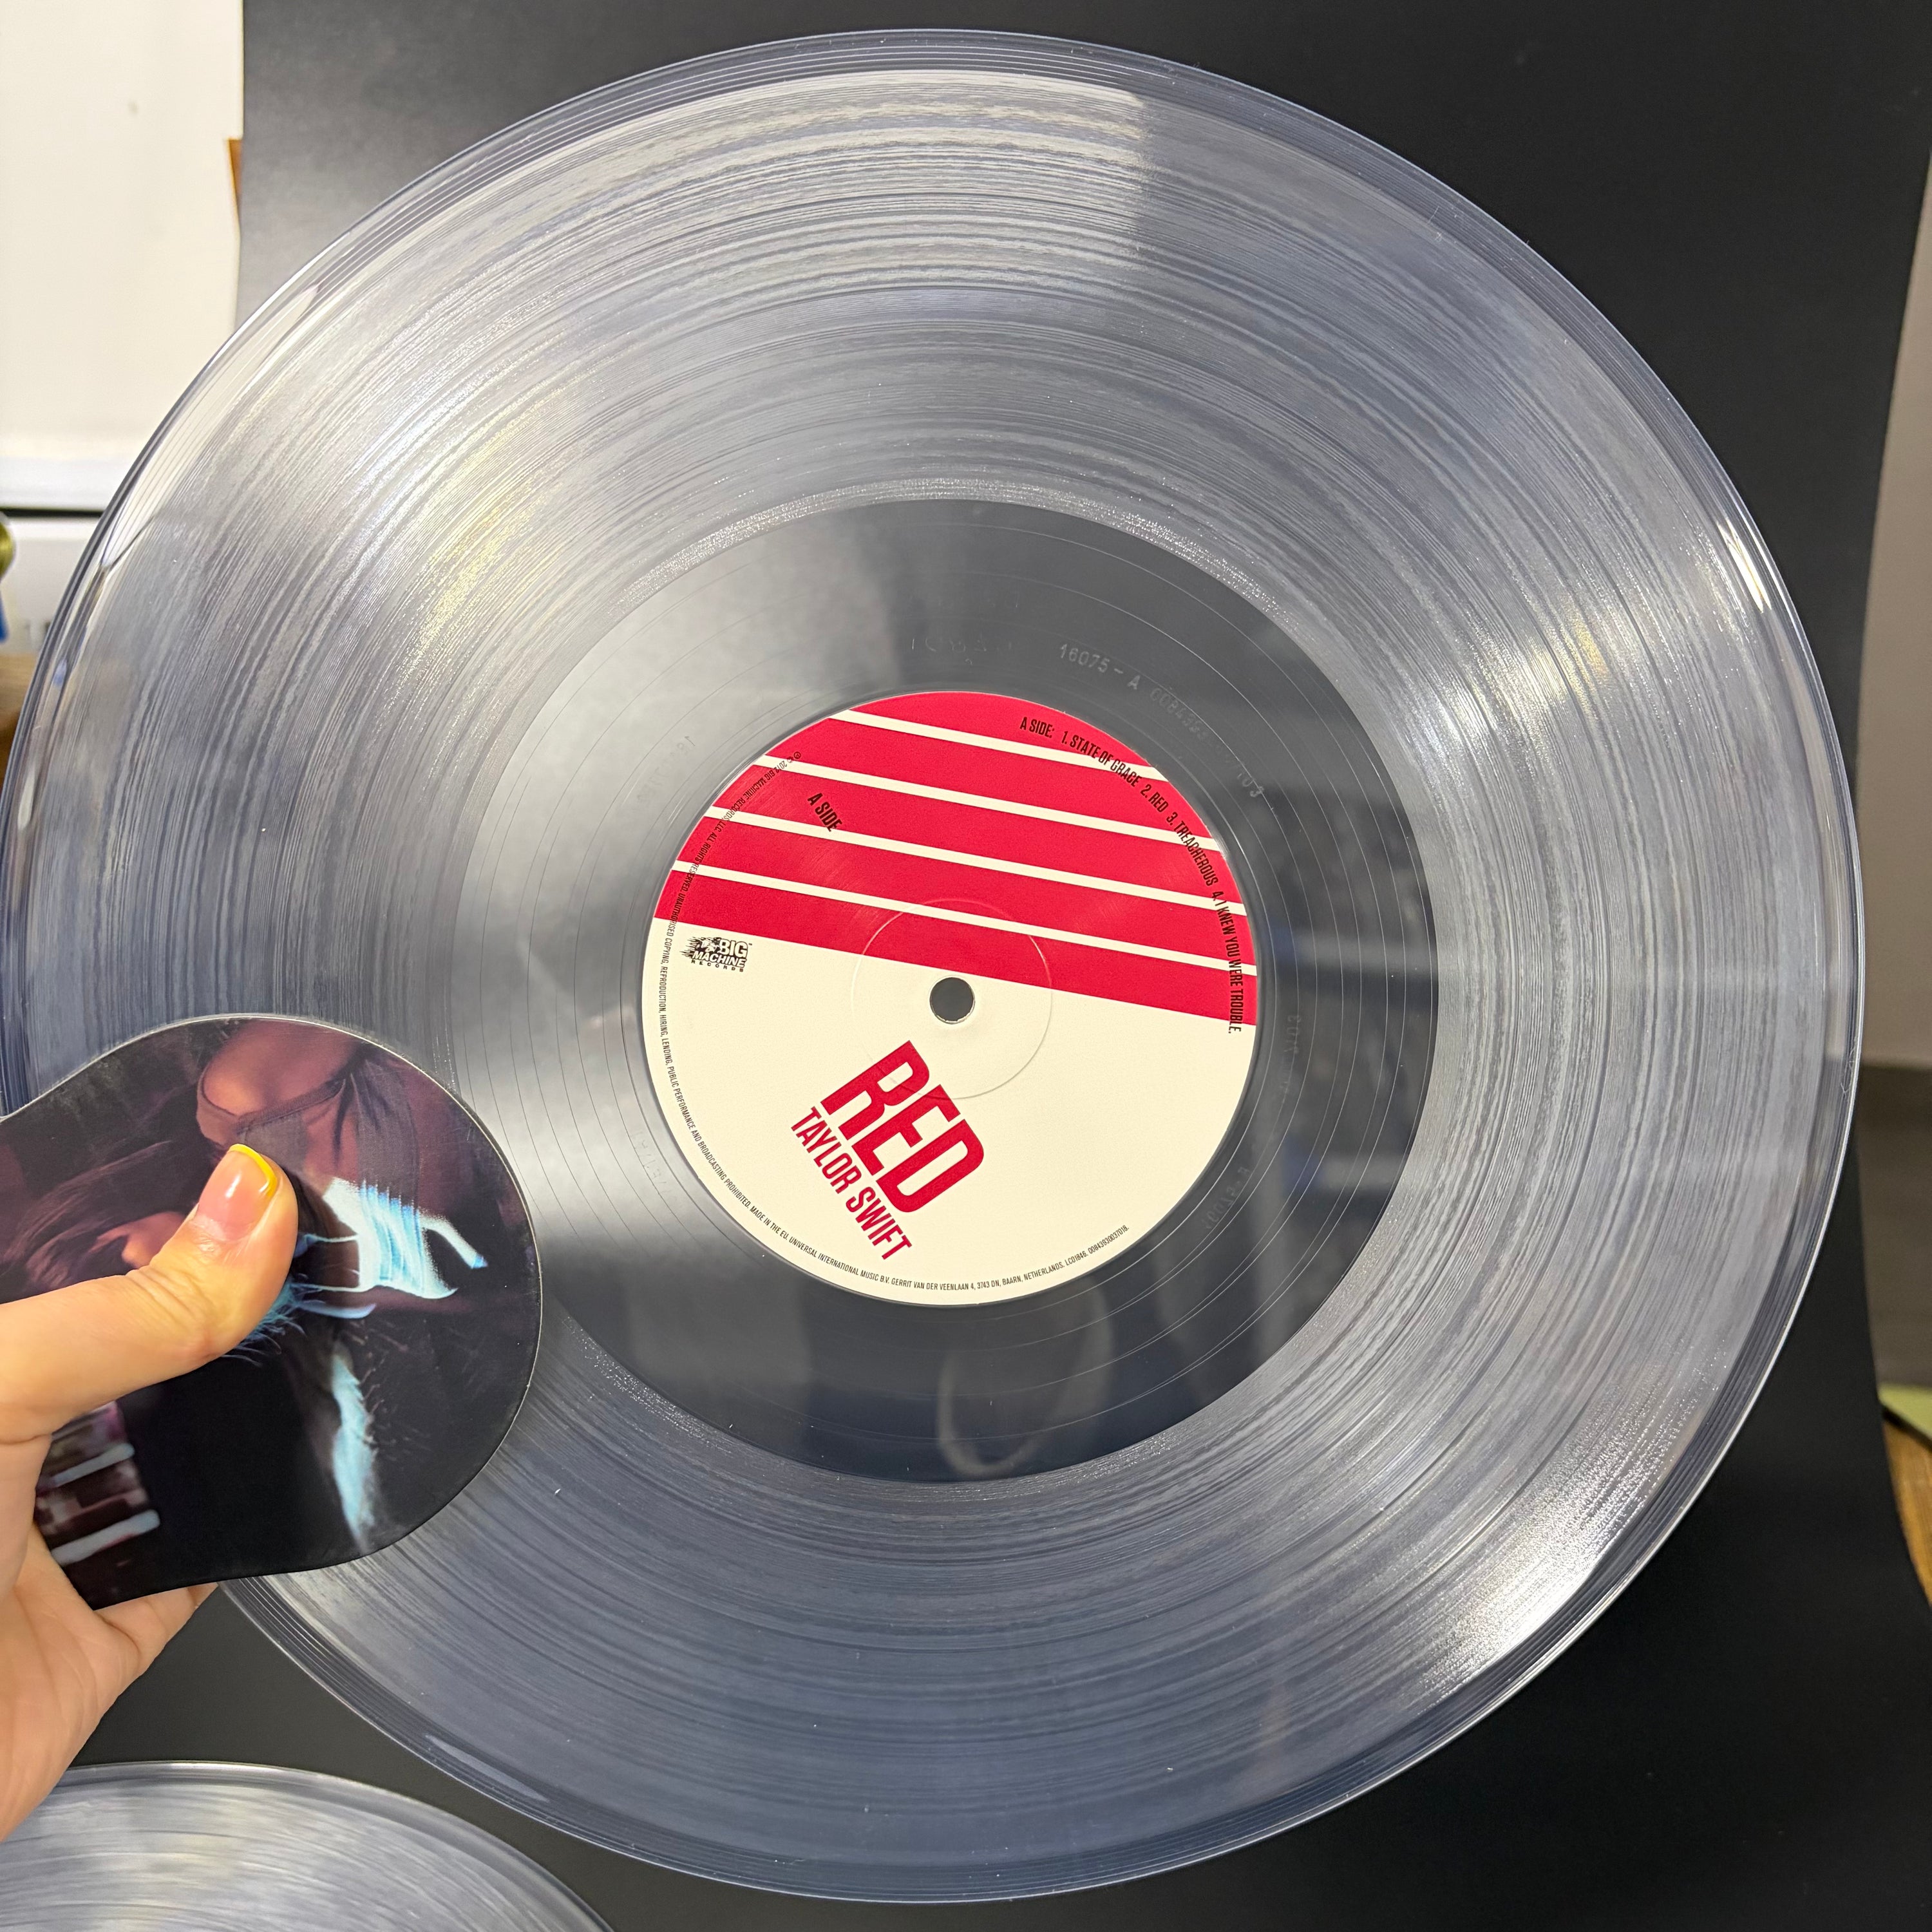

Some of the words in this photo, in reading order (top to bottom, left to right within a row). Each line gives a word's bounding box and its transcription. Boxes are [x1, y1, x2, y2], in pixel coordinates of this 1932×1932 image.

[1020, 717, 1027, 730] A
[1029, 719, 1054, 737] SIDE:
[1062, 732, 1068, 744] 1.
[1070, 735, 1101, 758] STATE
[774, 761, 787, 773] 2012
[1099, 751, 1113, 767] OF
[764, 768, 775, 780] BIG
[1110, 759, 1142, 786] GRACE
[1141, 784, 1151, 797] 2.
[721, 798, 745, 822] RECORDS,
[1149, 792, 1168, 812] RED
[807, 793, 823, 806] A
[815, 802, 842, 832] SIDE
[1167, 812, 1177, 825] 3.
[715, 819, 725, 831] LLC.
[707, 833, 717, 841] ALL
[696, 843, 710, 865] RIGHTS
[1174, 821, 1218, 886] TREACHEROUS
[682, 862, 699, 891] RESERVED.
[1211, 891, 1224, 901] 4.
[667, 893, 685, 936] UNAUTHORISED
[1217, 907, 1235, 934] KNEW
[661, 938, 672, 964] COPYING,
[719, 938, 748, 958] BIG
[1226, 937, 1240, 957] YOU
[691, 960, 744, 972] RECORDS
[692, 951, 747, 968] MACHINE
[1229, 959, 1243, 986] WERE
[659, 967, 668, 1013] REPRODUCTION,
[1229, 989, 1243, 1033] TROUBLE.
[662, 1038, 672, 1065] LENDING,
[667, 1066, 679, 1087] PUBLIC
[674, 1088, 696, 1129] PERFORMANCE
[691, 1130, 701, 1141] AND
[820, 1040, 984, 1212] RED
[698, 1141, 726, 1180] BROADCASTING
[791, 1106, 862, 1193] TAYLOR
[846, 1186, 913, 1260] SWIFT
[724, 1179, 751, 1208] PROHIBITED.
[750, 1206, 765, 1220] MADE
[770, 1223, 781, 1233] THE
[780, 1231, 789, 1240] EU.
[789, 1236, 817, 1257] UNIVERSAL
[818, 1253, 858, 1275] INTERNATIONAL
[1024, 1262, 1065, 1280] NETHERLANDS.
[860, 1270, 878, 1281] MUSIC
[891, 1278, 912, 1287] GERRIT
[1003, 1276, 1023, 1285] BAARN,
